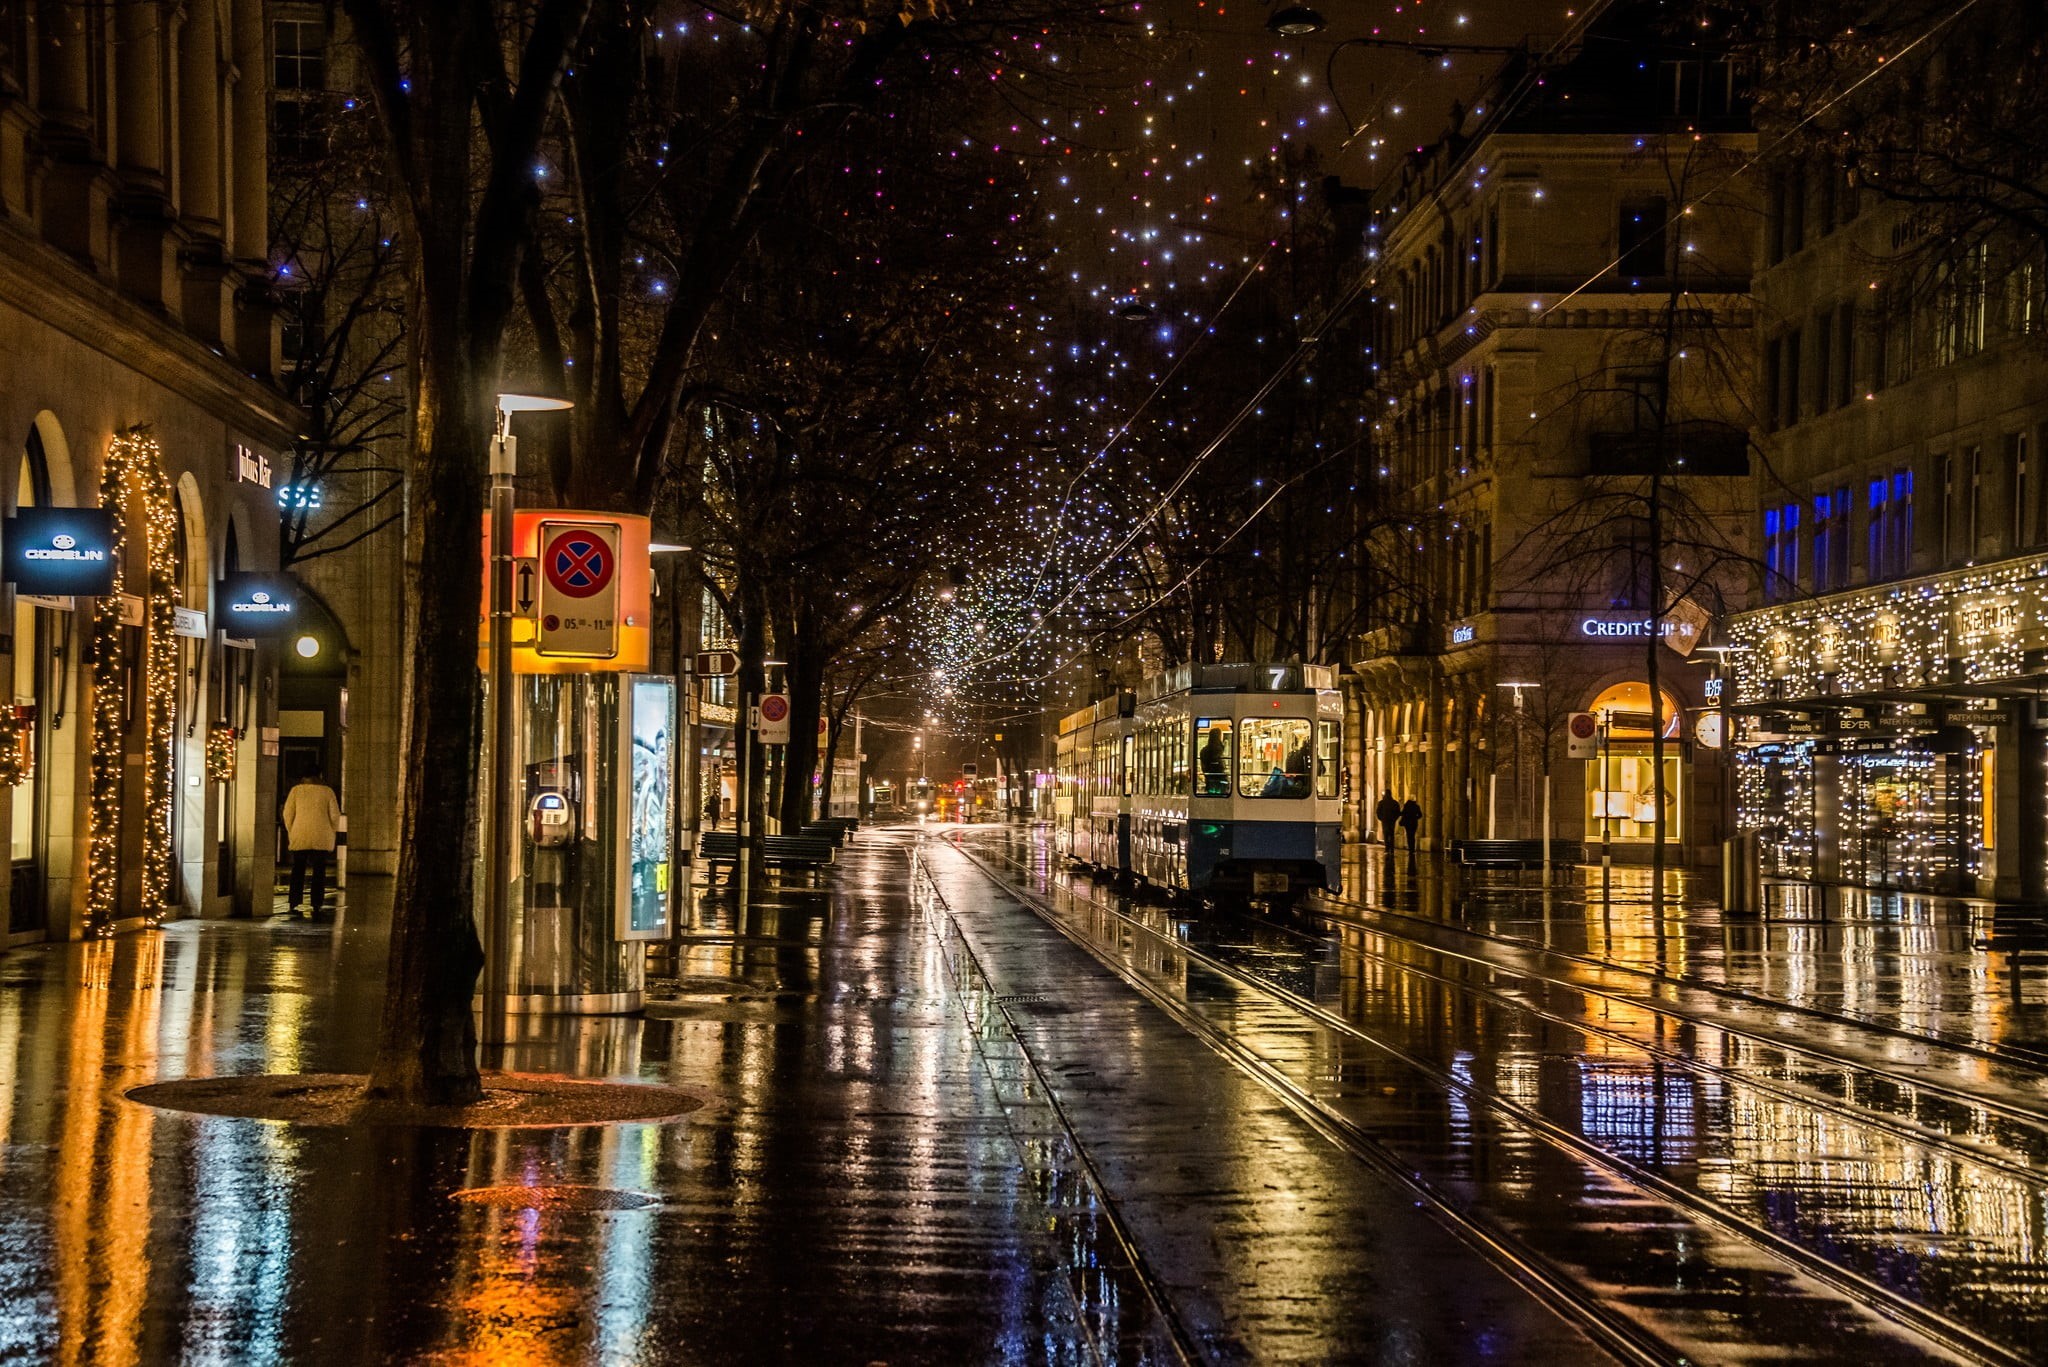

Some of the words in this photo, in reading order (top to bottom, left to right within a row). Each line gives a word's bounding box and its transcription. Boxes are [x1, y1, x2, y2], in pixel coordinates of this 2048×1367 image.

[1582, 619, 1643, 636] CREDIT
[1269, 667, 1286, 691] 7
[1879, 717, 1901, 726] PATEK
[1948, 713, 1972, 723] PATEK
[1973, 713, 2008, 722] PHILIPPE
[1788, 723, 1812, 732] Jewels
[1840, 720, 1871, 729] BEYER
